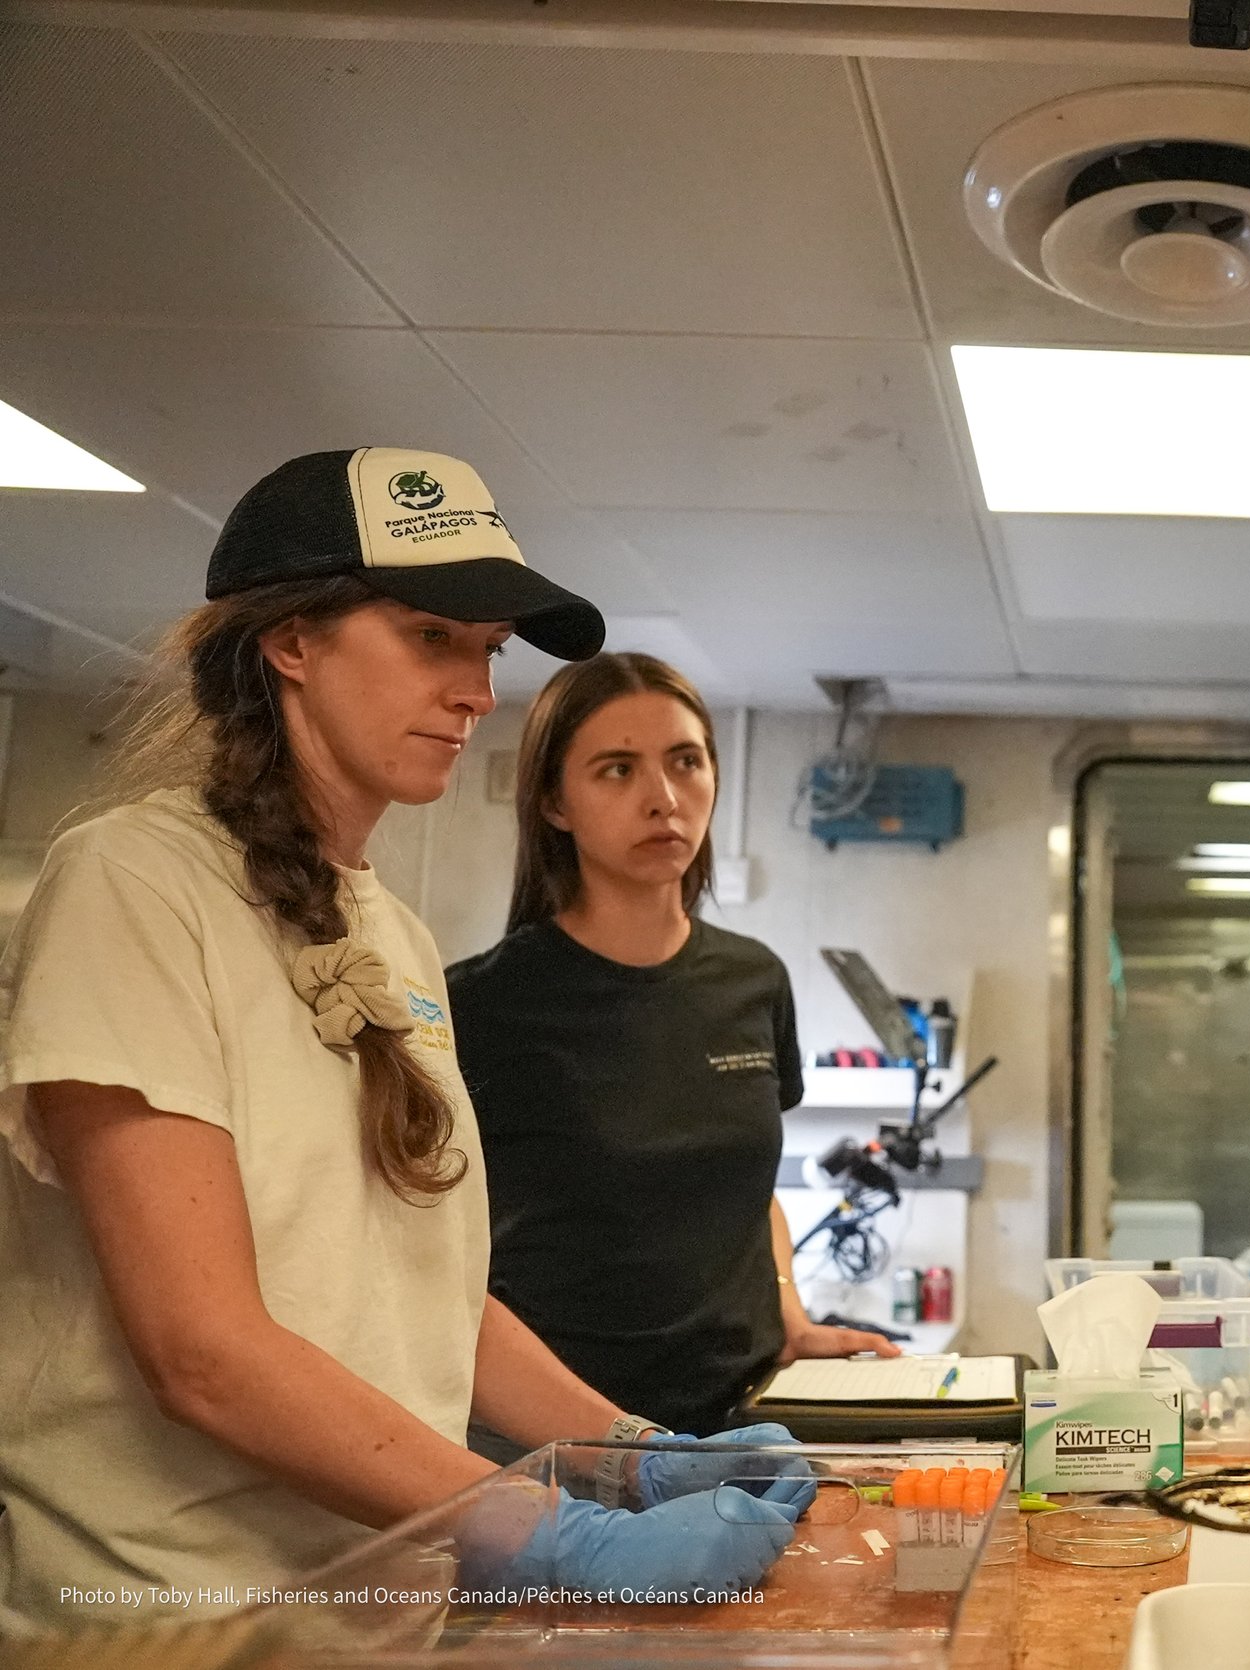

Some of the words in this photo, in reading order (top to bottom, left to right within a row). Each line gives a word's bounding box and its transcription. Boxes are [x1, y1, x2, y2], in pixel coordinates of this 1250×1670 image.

[385, 515, 425, 528] Parque
[427, 509, 474, 519] Nacional
[391, 517, 477, 538] GALÁPAGOS
[412, 529, 461, 543] ECUADOR
[1056, 1421, 1093, 1429] Kimwipes
[1056, 1429, 1151, 1446] KIMTECH
